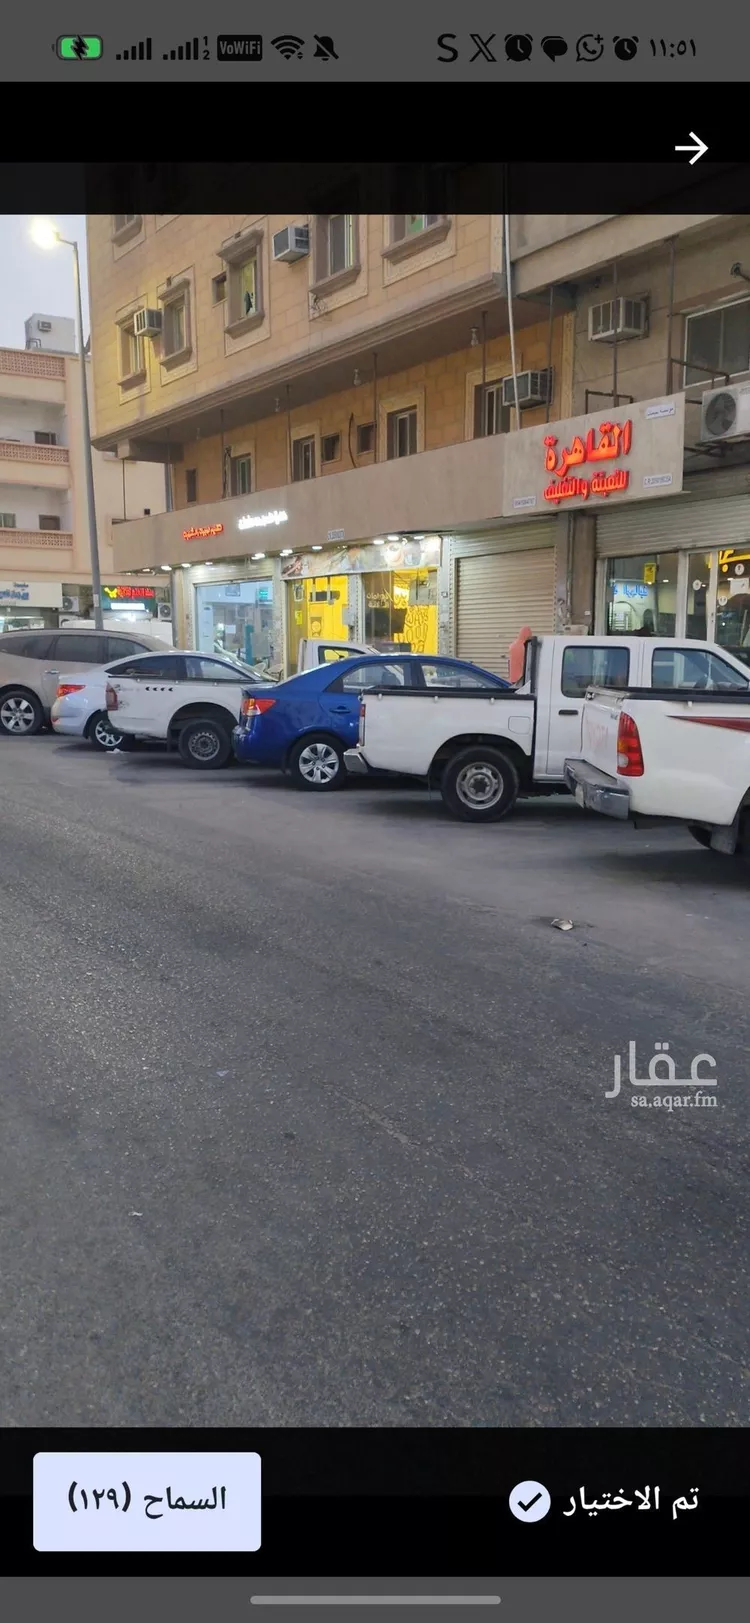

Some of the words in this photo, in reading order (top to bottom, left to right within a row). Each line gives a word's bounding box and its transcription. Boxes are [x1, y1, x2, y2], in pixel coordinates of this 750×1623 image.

[544, 419, 632, 477] القاهرة
[544, 477, 589, 504] والتغليف
[590, 469, 629, 498] للتعبئة
